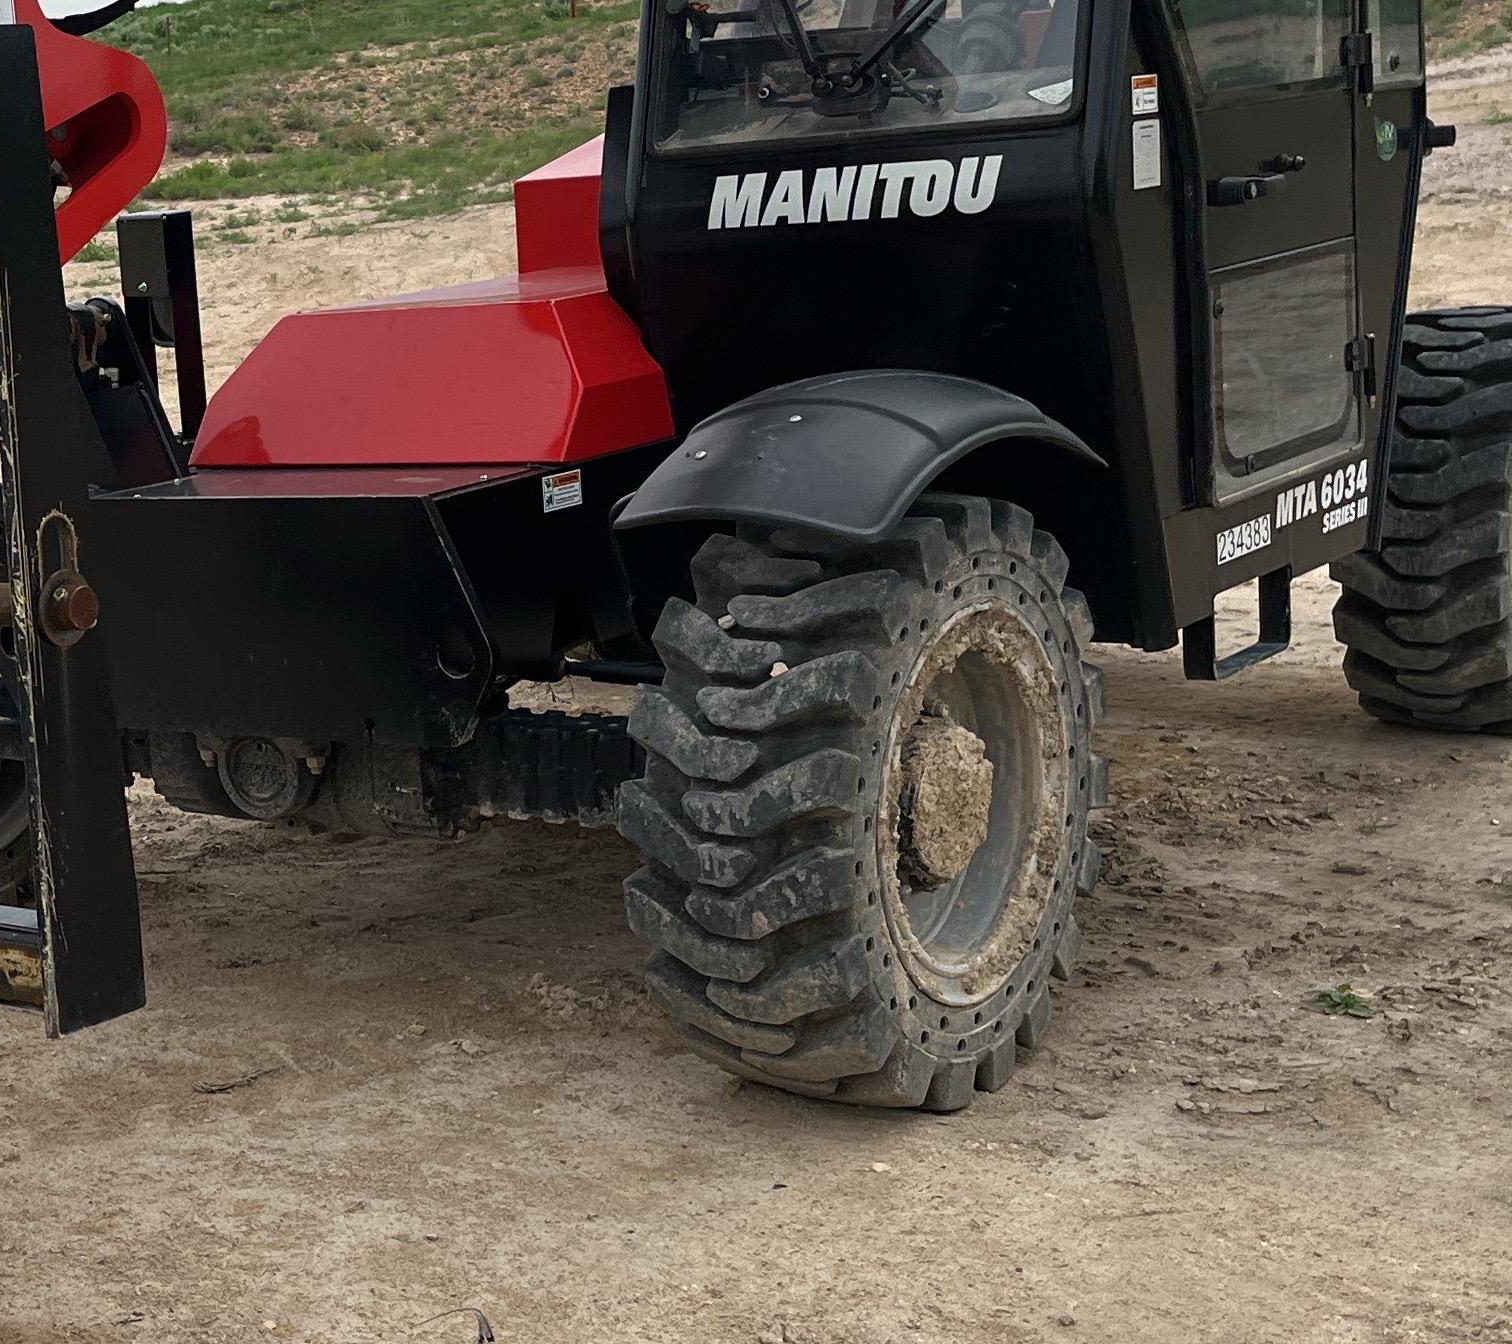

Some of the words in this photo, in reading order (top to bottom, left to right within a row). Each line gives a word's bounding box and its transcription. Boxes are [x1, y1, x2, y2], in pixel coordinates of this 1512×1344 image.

[707, 154, 1004, 230] MANITOU
[1275, 479, 1318, 530] MTA
[1320, 458, 1368, 510] 6034
[1322, 501, 1356, 535] SERIES
[1357, 496, 1368, 520] III
[1218, 516, 1270, 563] 234383
